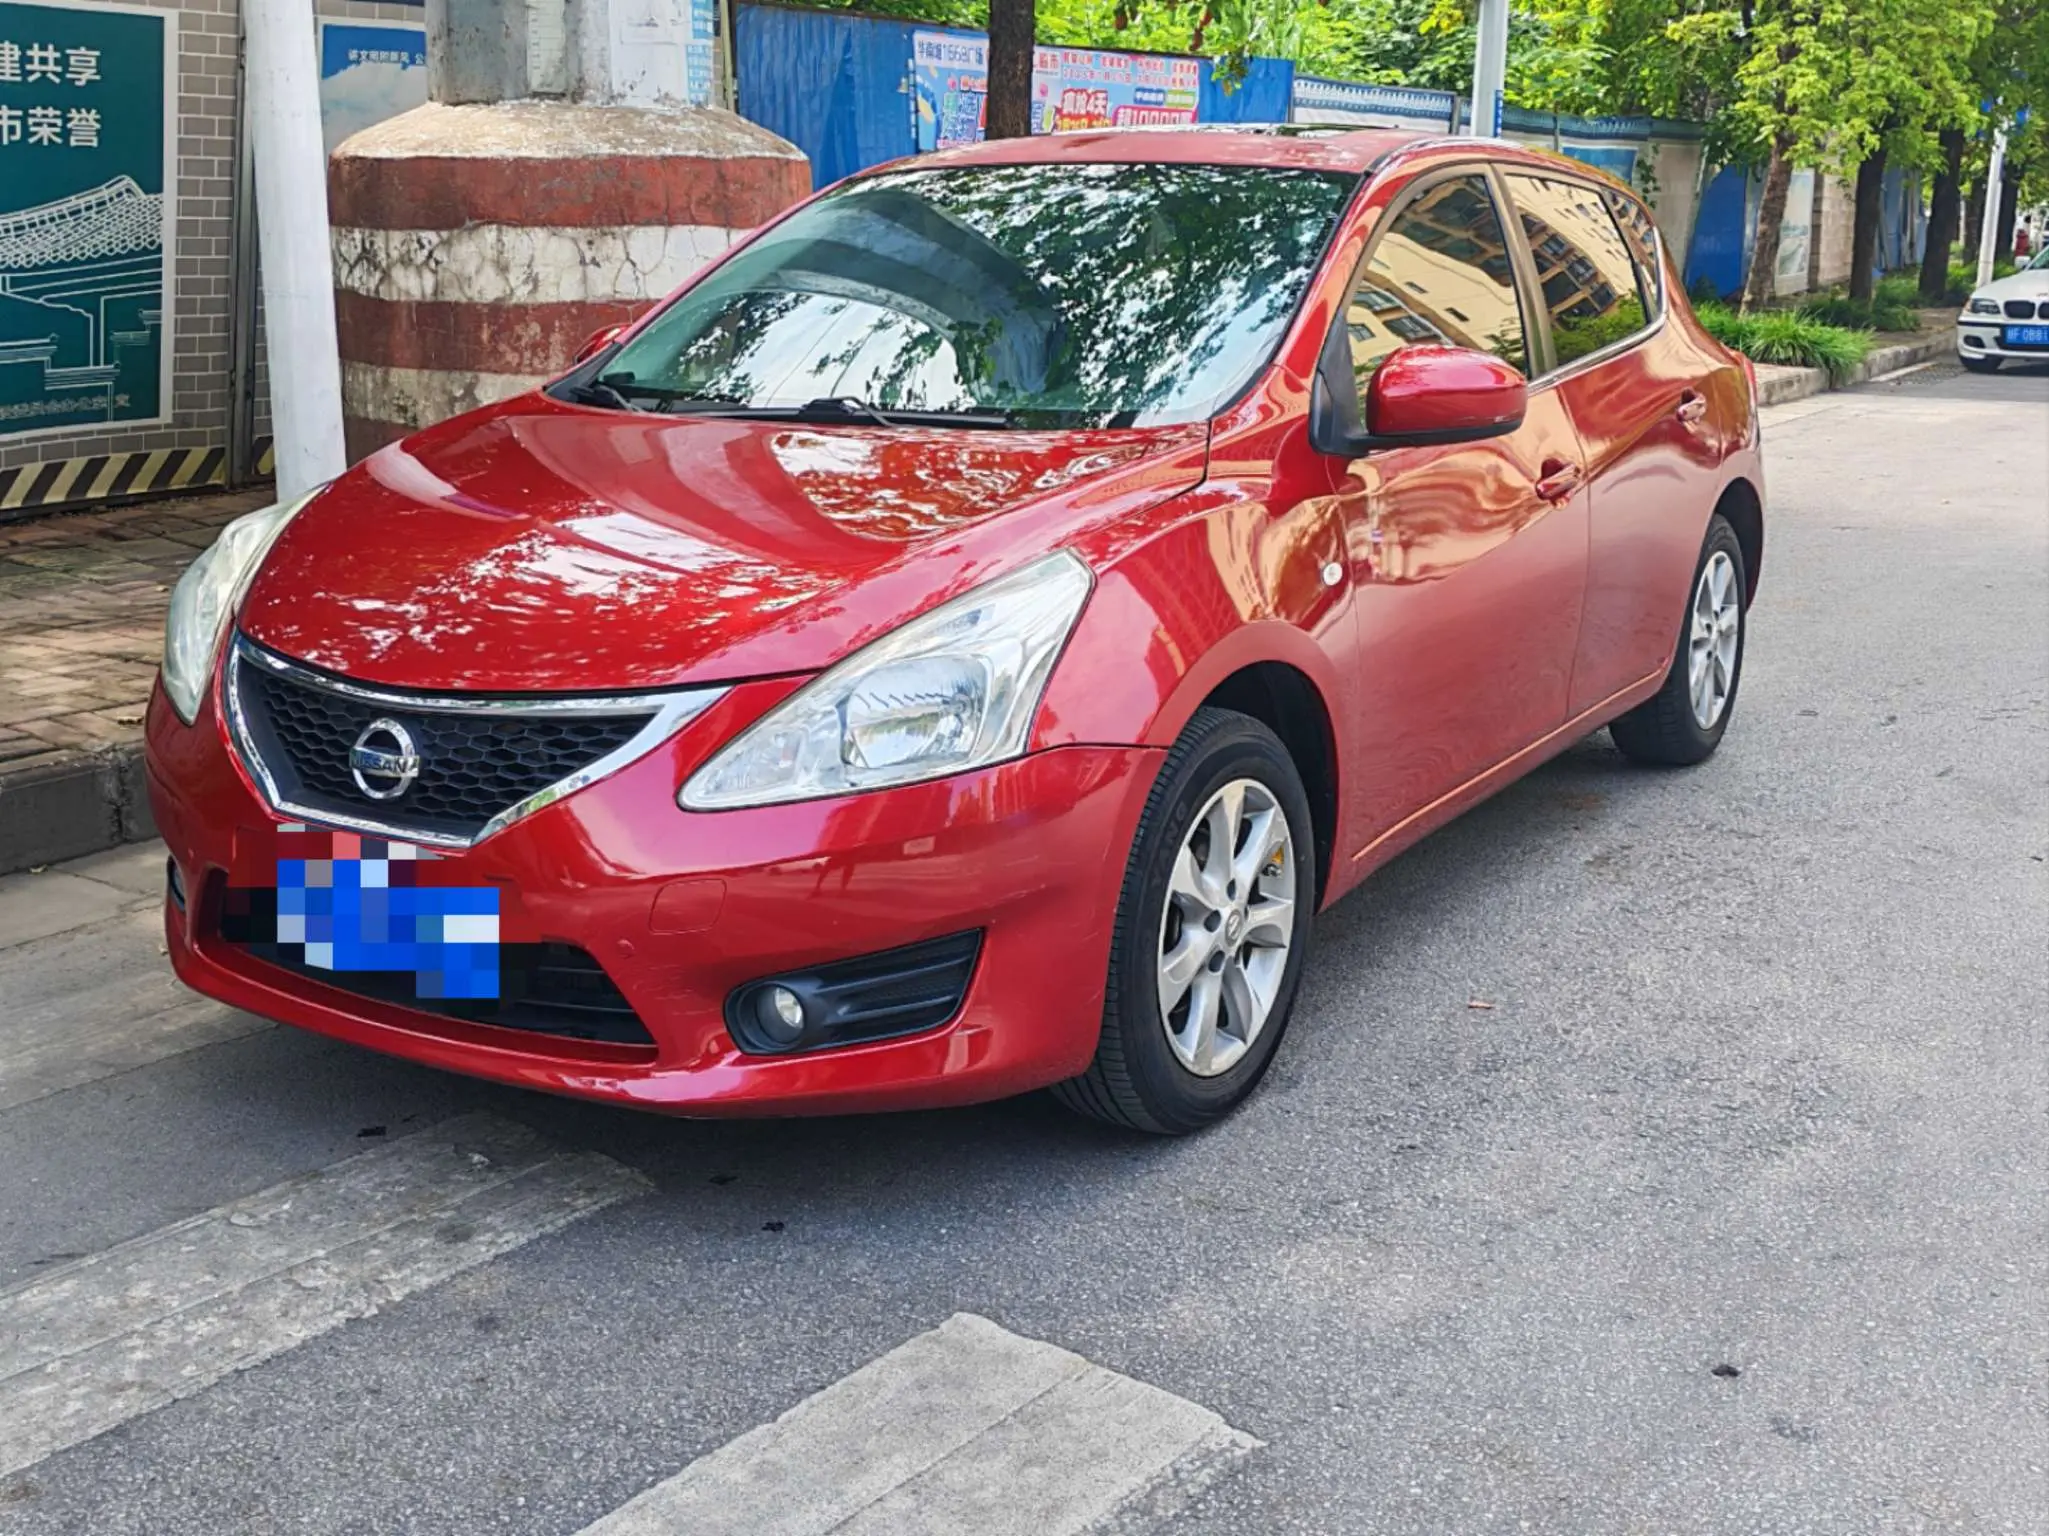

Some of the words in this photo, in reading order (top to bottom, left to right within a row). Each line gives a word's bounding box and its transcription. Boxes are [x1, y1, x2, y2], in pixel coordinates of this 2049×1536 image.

[0, 40, 101, 86] 建共享
[0, 104, 102, 148] 市荣誉
